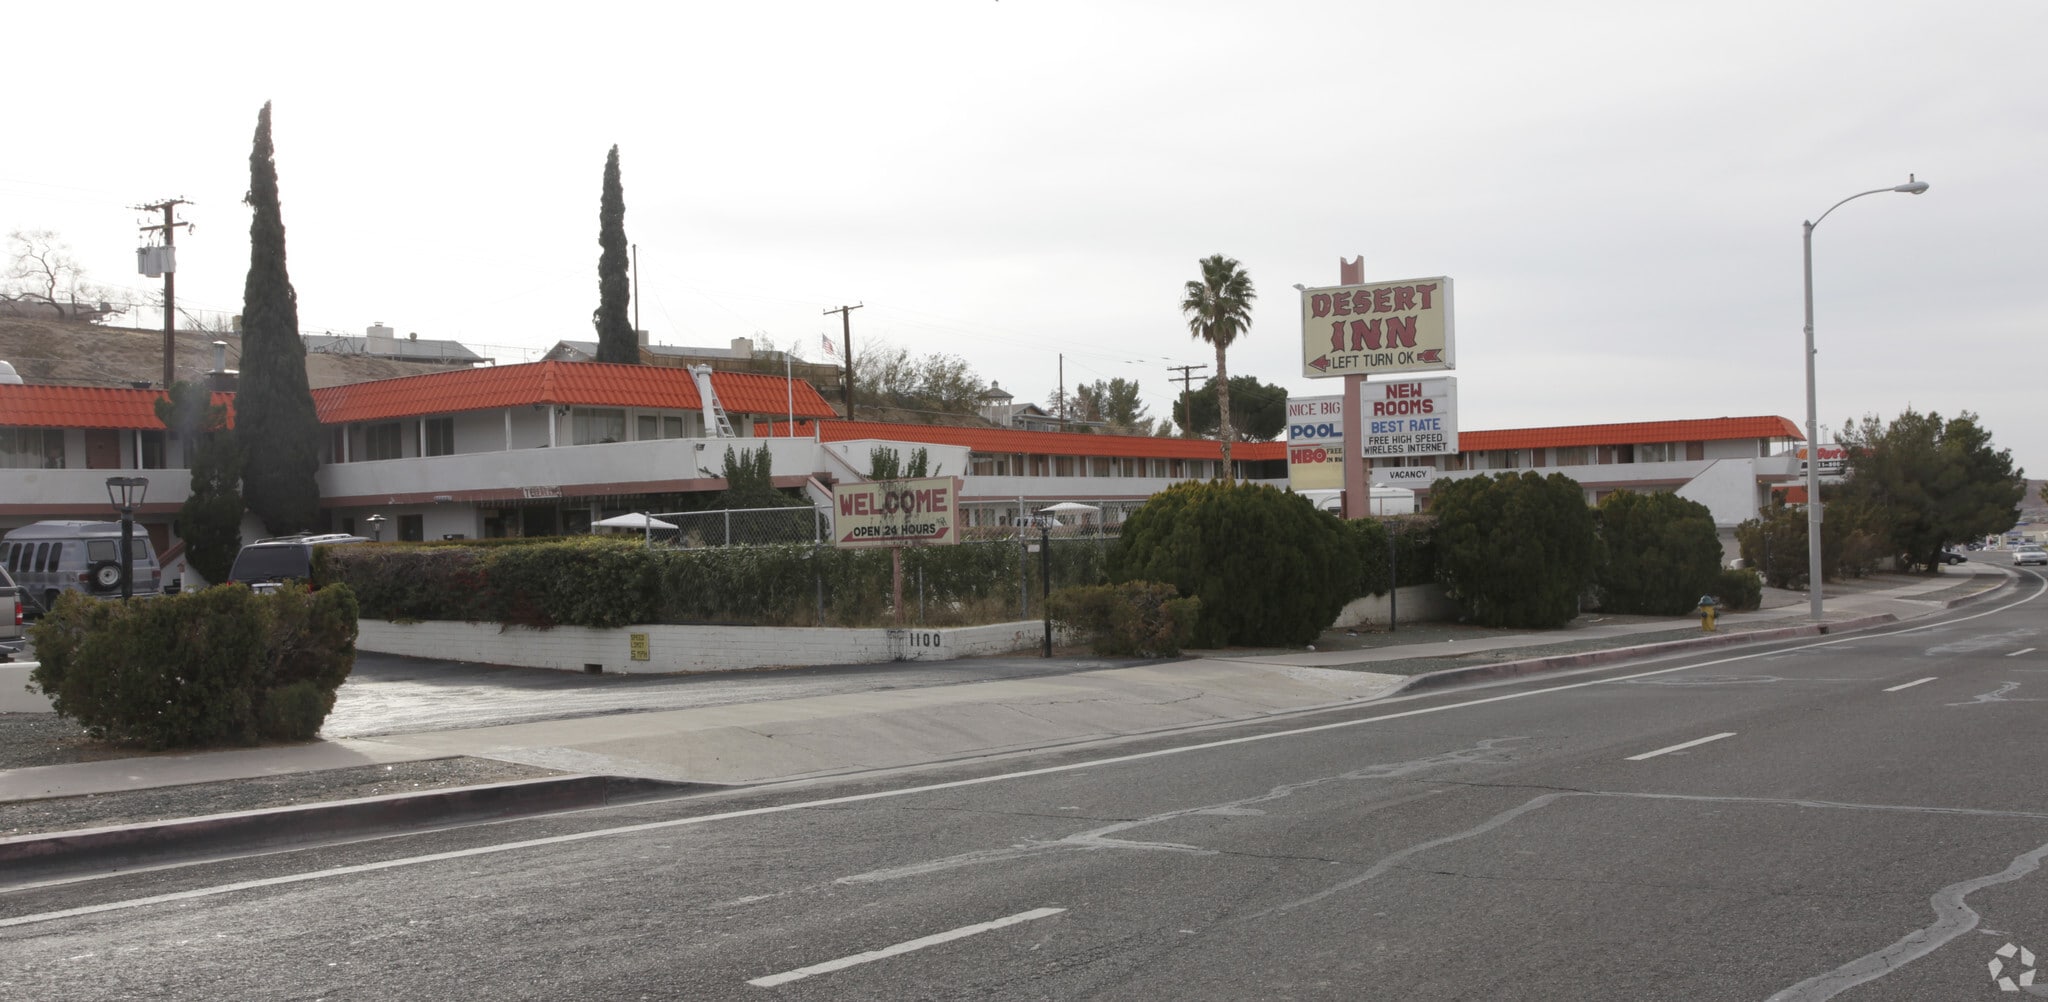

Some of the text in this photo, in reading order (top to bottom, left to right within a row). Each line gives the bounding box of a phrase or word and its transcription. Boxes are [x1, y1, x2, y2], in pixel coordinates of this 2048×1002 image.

[1311, 283, 1437, 318] DESERT
[1331, 315, 1418, 353] INN
[1332, 351, 1415, 369] LEFT TURN OK
[1386, 382, 1422, 399] NEW
[1289, 401, 1341, 416] NICE BIG
[1374, 398, 1433, 416] ROOMS
[1290, 423, 1343, 440] POOL
[1371, 418, 1441, 434] BEST RATE
[1368, 433, 1443, 445] FREE HIGH SPEED
[1291, 448, 1327, 464] HBO
[1364, 442, 1447, 455] WIRELESS INTERNET
[1389, 470, 1427, 479] VACANCY
[839, 488, 948, 516] WELCOME
[853, 523, 936, 537] OPEN 24 HOURS
[910, 633, 940, 647] 1100
